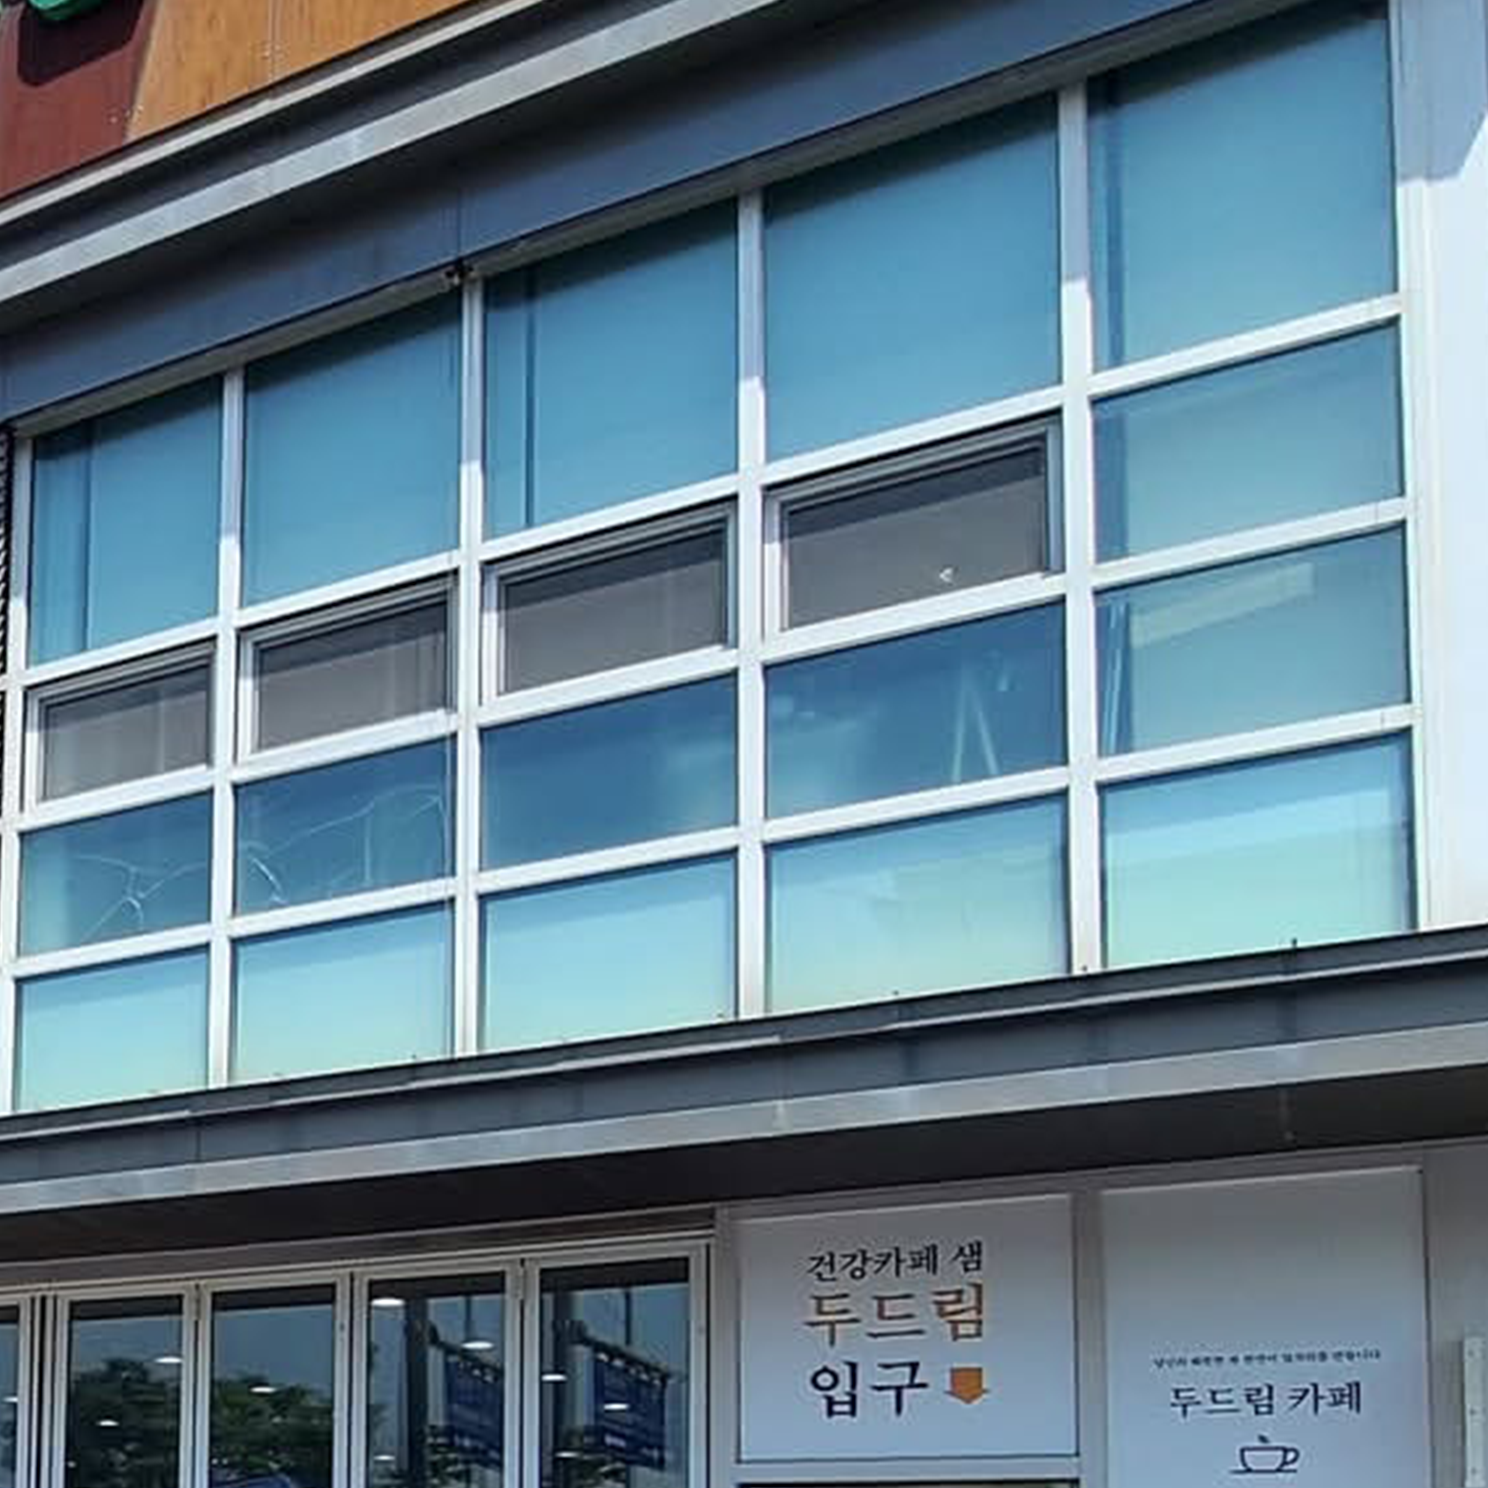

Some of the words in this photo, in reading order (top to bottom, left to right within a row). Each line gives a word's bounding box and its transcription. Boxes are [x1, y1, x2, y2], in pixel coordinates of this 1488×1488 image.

[807, 1244, 938, 1282] 건강카페
[951, 1240, 983, 1274] 샘
[803, 1281, 984, 1348] 두드림
[810, 1361, 929, 1418] 입구
[1170, 1382, 1274, 1418] 두드림
[1287, 1380, 1361, 1415] 카페
